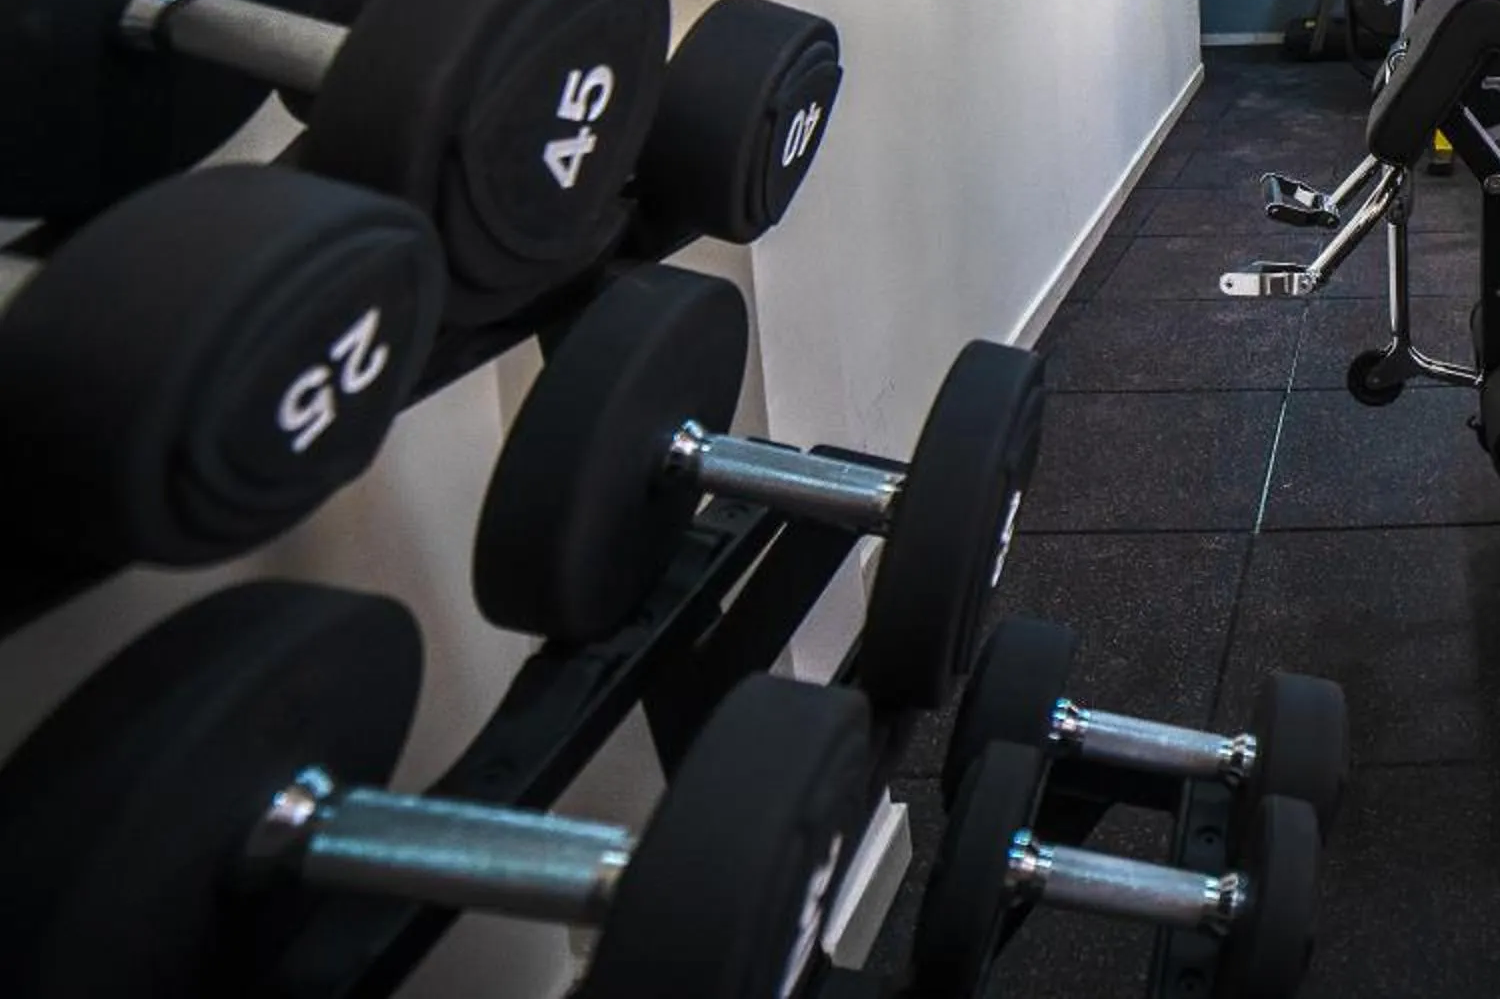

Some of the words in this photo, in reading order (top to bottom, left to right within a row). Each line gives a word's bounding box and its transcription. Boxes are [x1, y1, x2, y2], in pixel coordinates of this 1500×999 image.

[542, 63, 616, 190] 45
[781, 101, 823, 168] 40
[277, 306, 391, 454] 25
